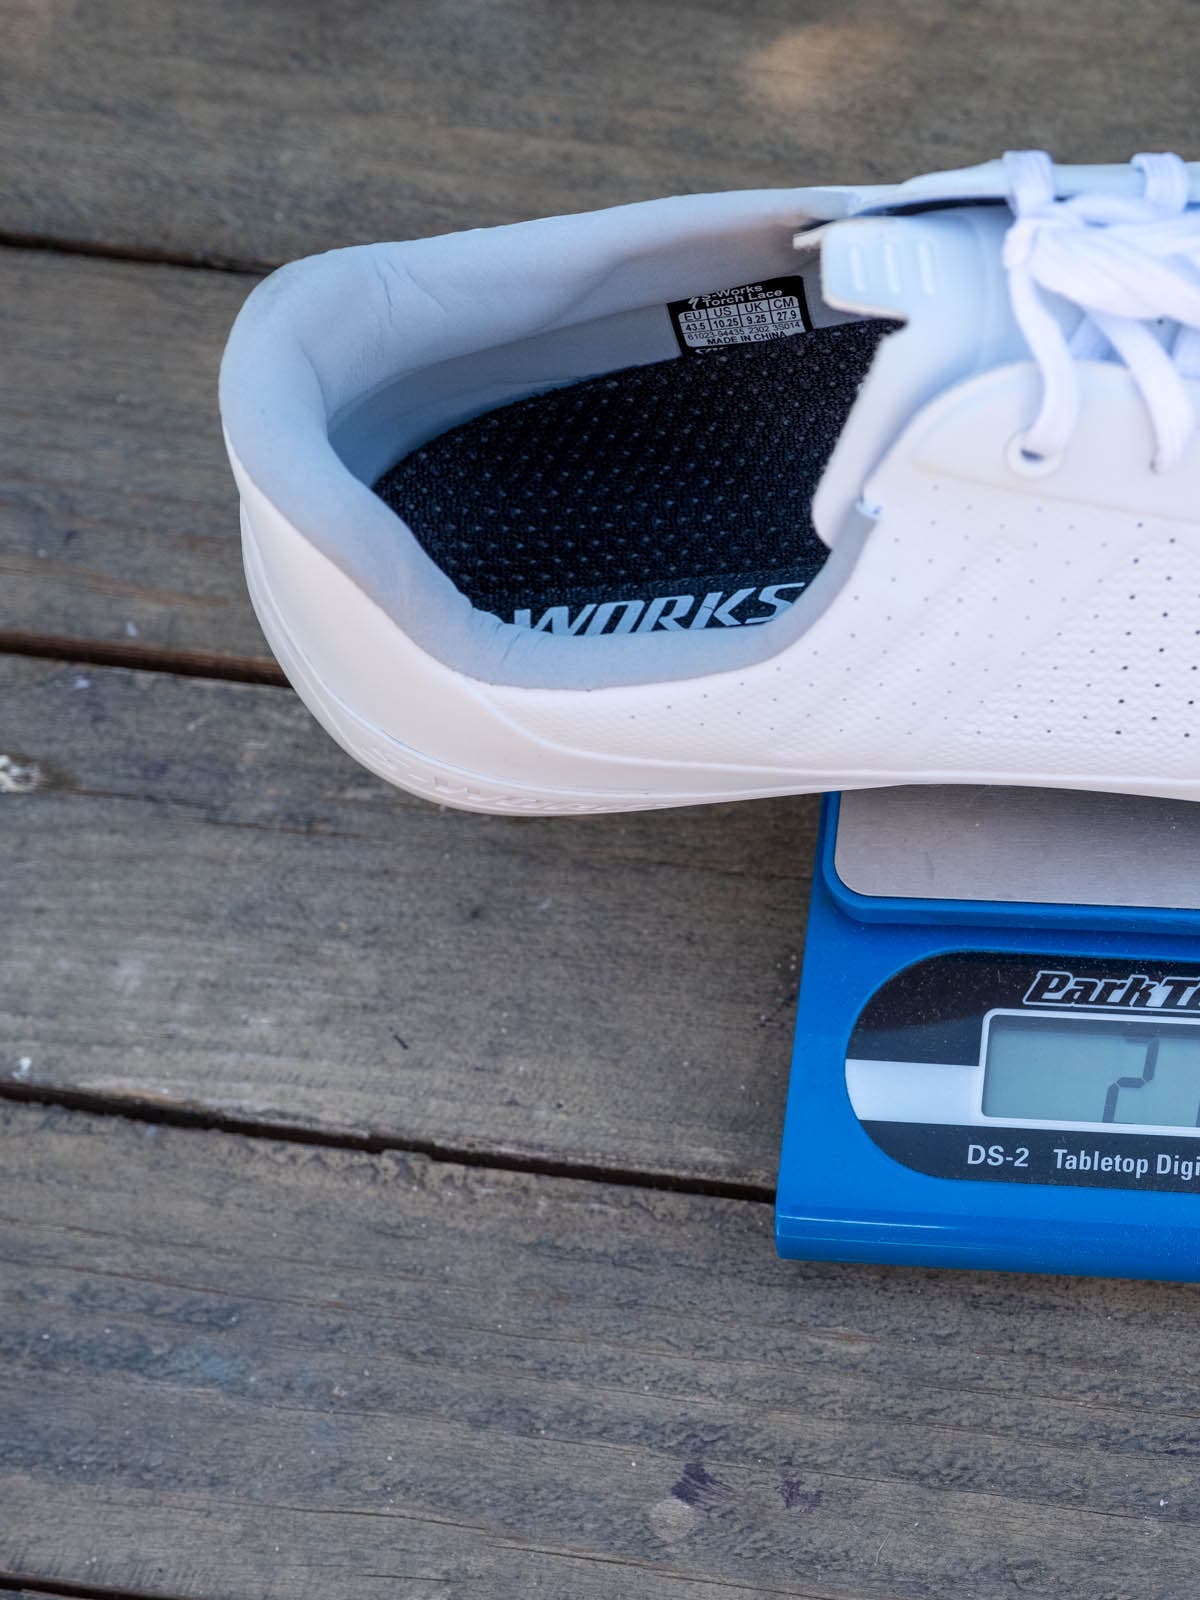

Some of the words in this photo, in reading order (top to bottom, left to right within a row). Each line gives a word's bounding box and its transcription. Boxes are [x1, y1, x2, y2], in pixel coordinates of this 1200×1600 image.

[702, 295, 744, 307] Torch
[748, 290, 783, 300] Lace
[773, 297, 795, 309] CM
[714, 306, 732, 317] US
[745, 302, 764, 313] UK
[684, 311, 702, 321] EU
[746, 314, 767, 324] 9.25
[777, 310, 797, 321] 27.9
[686, 322, 706, 331] 43.5
[713, 318, 739, 329] 10.25
[707, 335, 738, 345] MADE
[753, 331, 787, 341] CHINA
[967, 1144, 1030, 1168] DS-2
[1053, 1148, 1150, 1178] Tabletop
